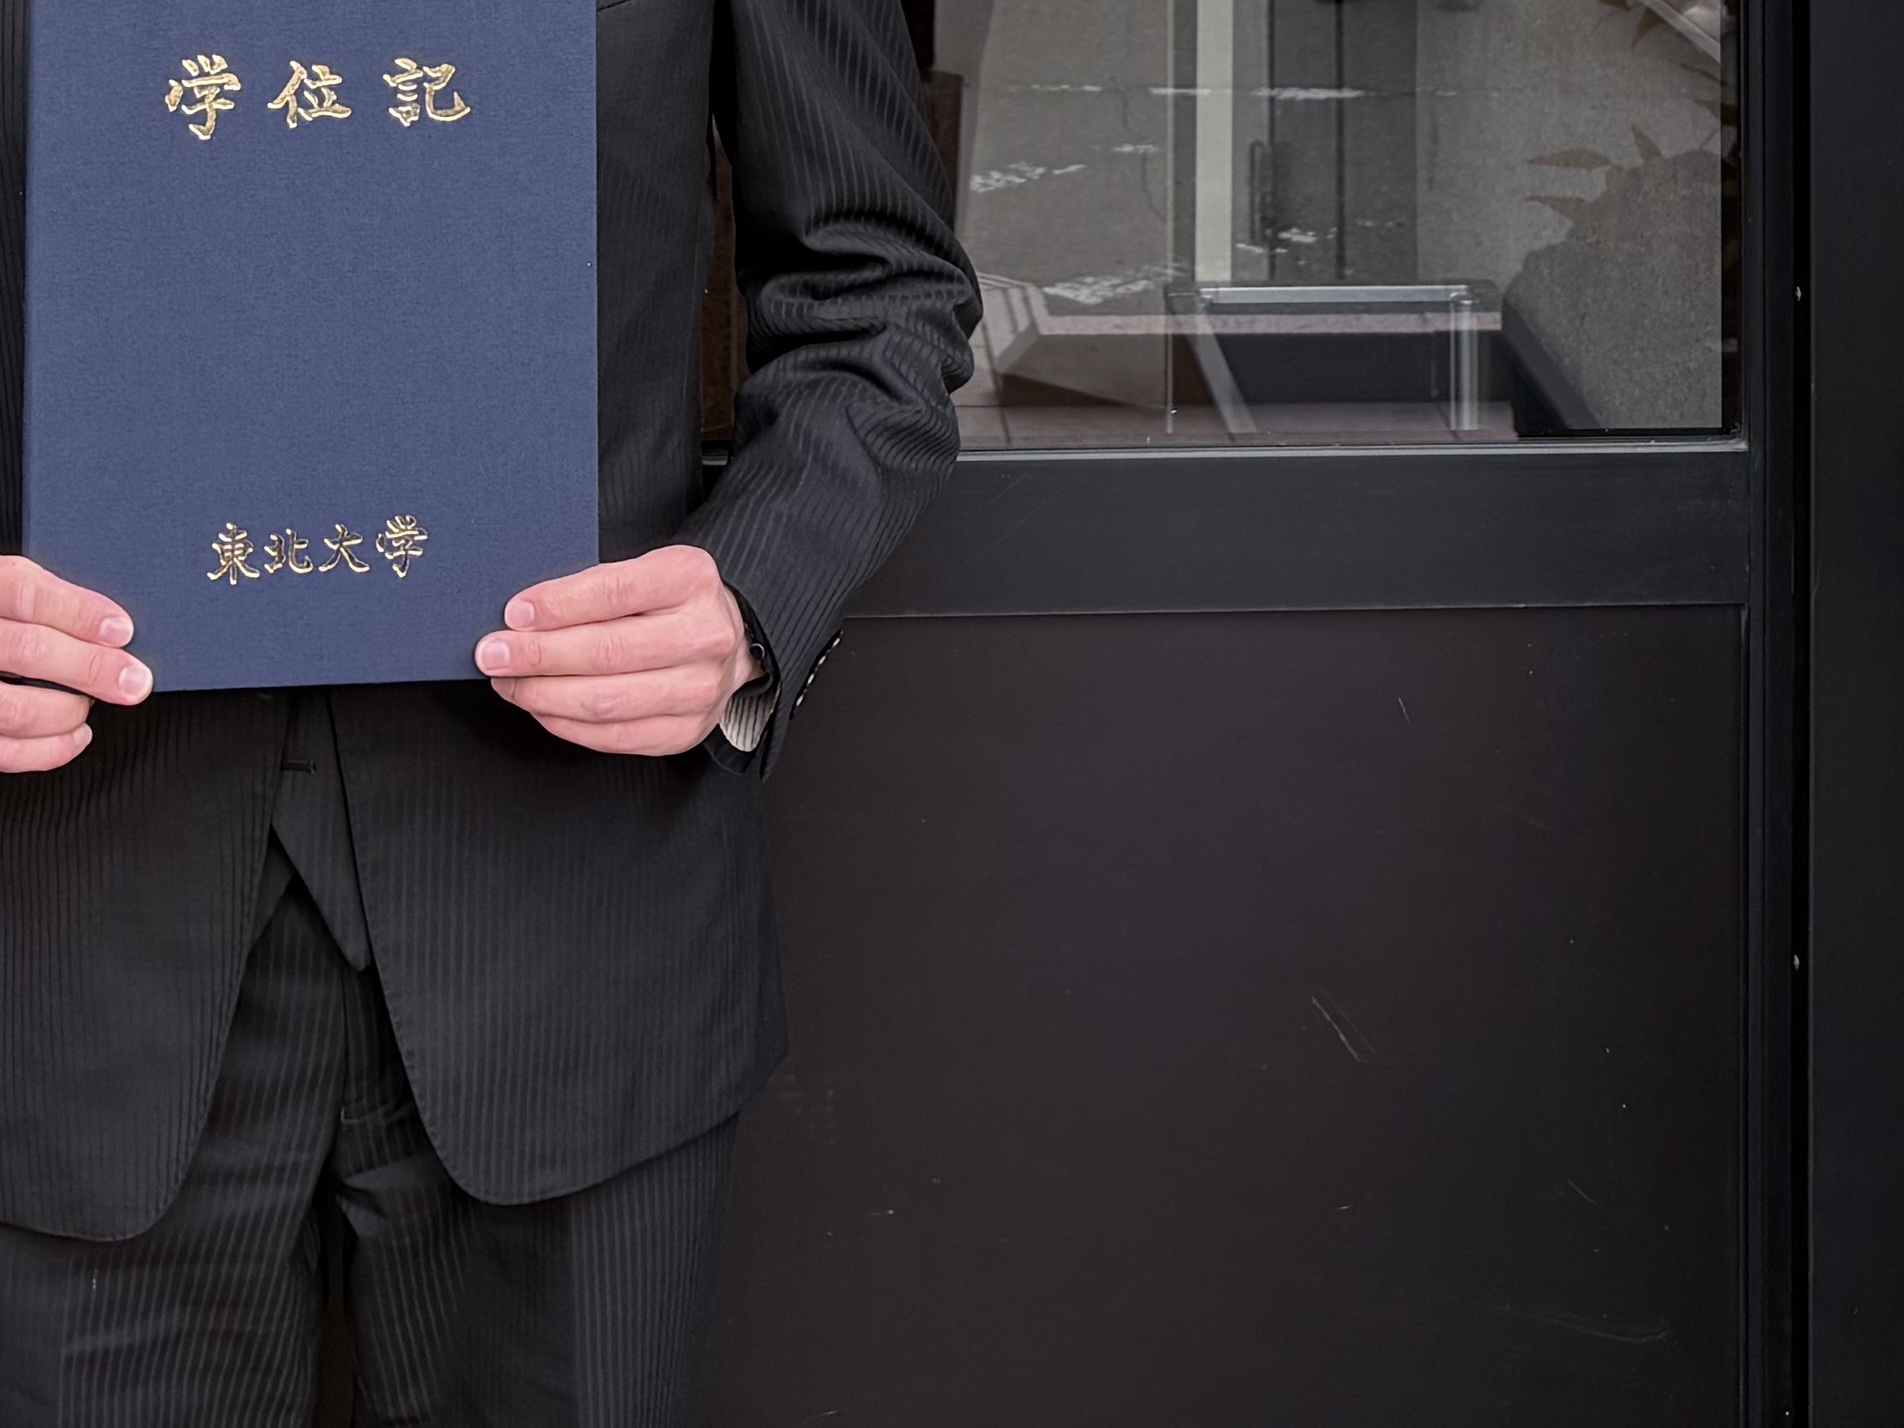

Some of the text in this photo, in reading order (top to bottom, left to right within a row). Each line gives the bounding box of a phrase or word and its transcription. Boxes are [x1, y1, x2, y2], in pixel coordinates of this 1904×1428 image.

[165, 54, 471, 140] 学位記
[207, 515, 428, 585] 東北大学
